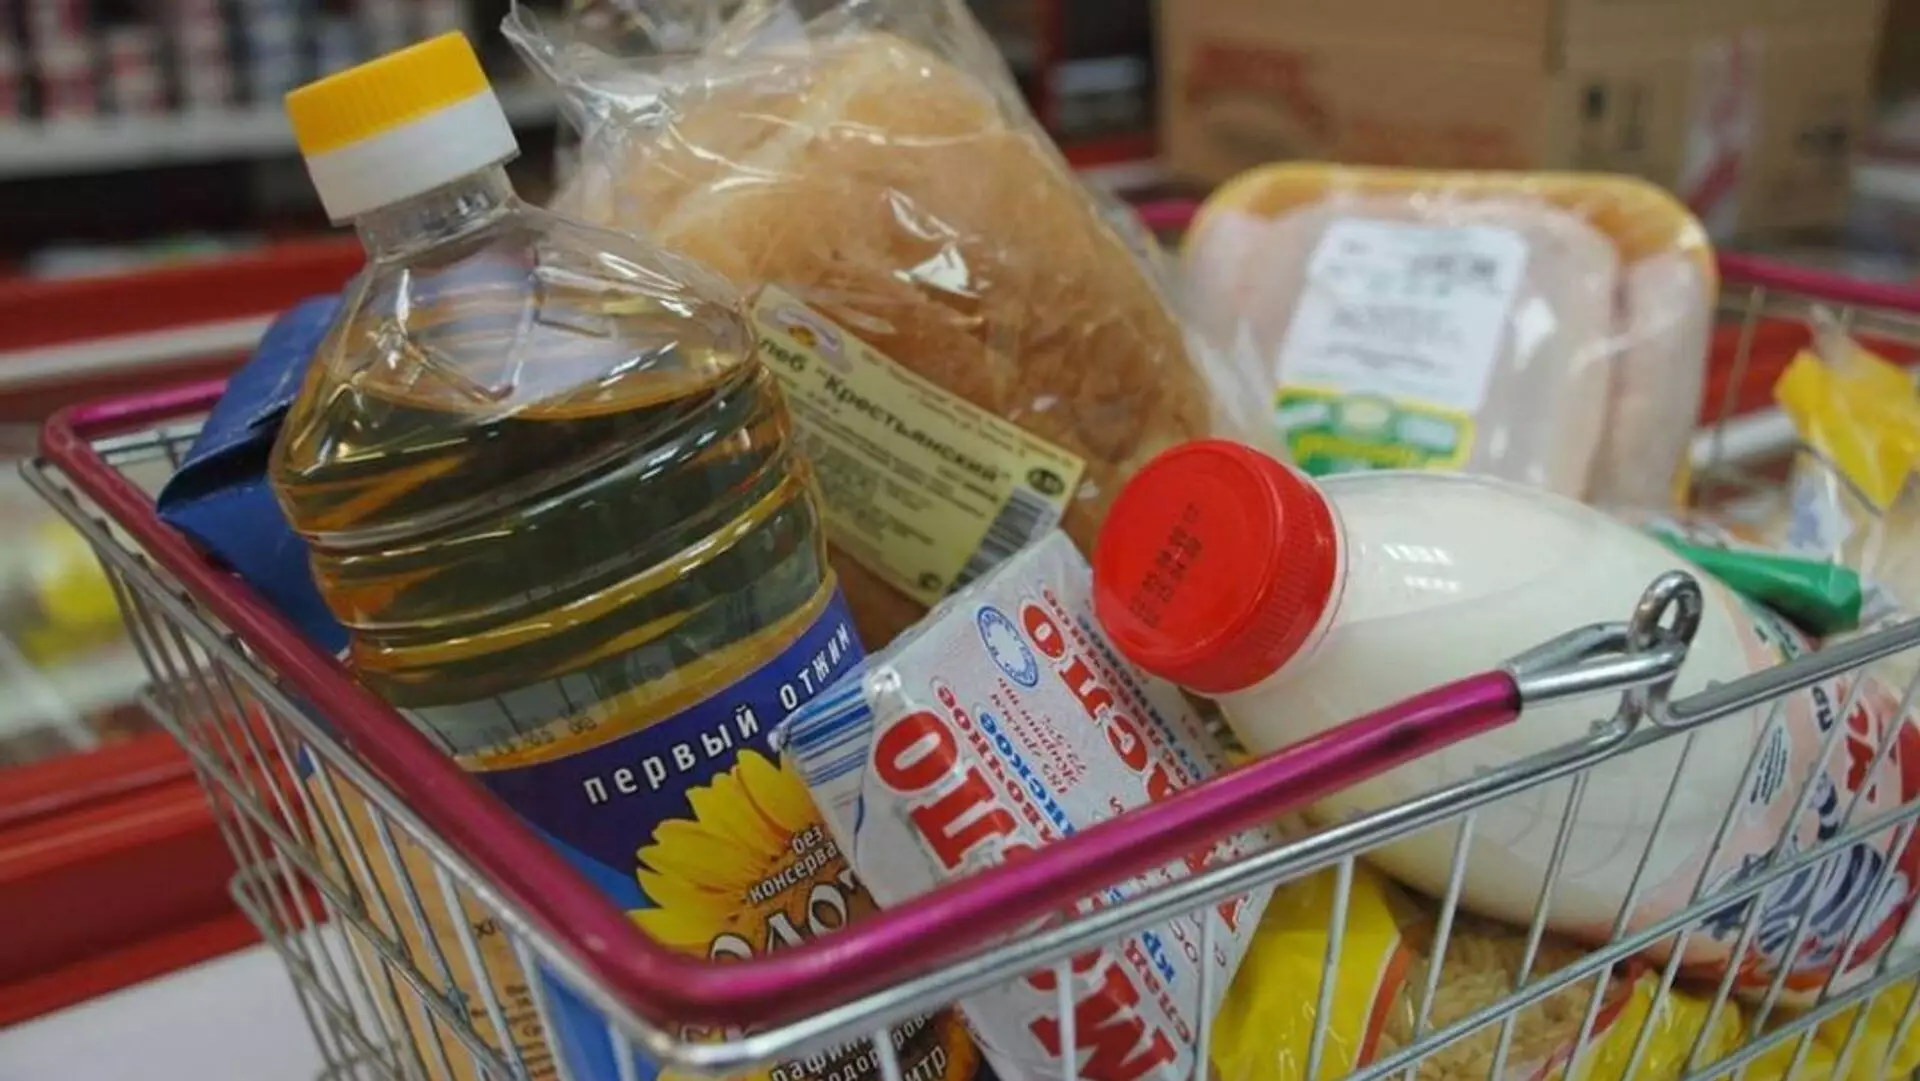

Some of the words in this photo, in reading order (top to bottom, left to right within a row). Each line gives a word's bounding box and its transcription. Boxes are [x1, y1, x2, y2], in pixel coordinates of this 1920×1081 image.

[759, 337, 808, 374] леб
[583, 706, 760, 805] первый
[790, 825, 824, 854] без
[749, 840, 838, 905] консерва
